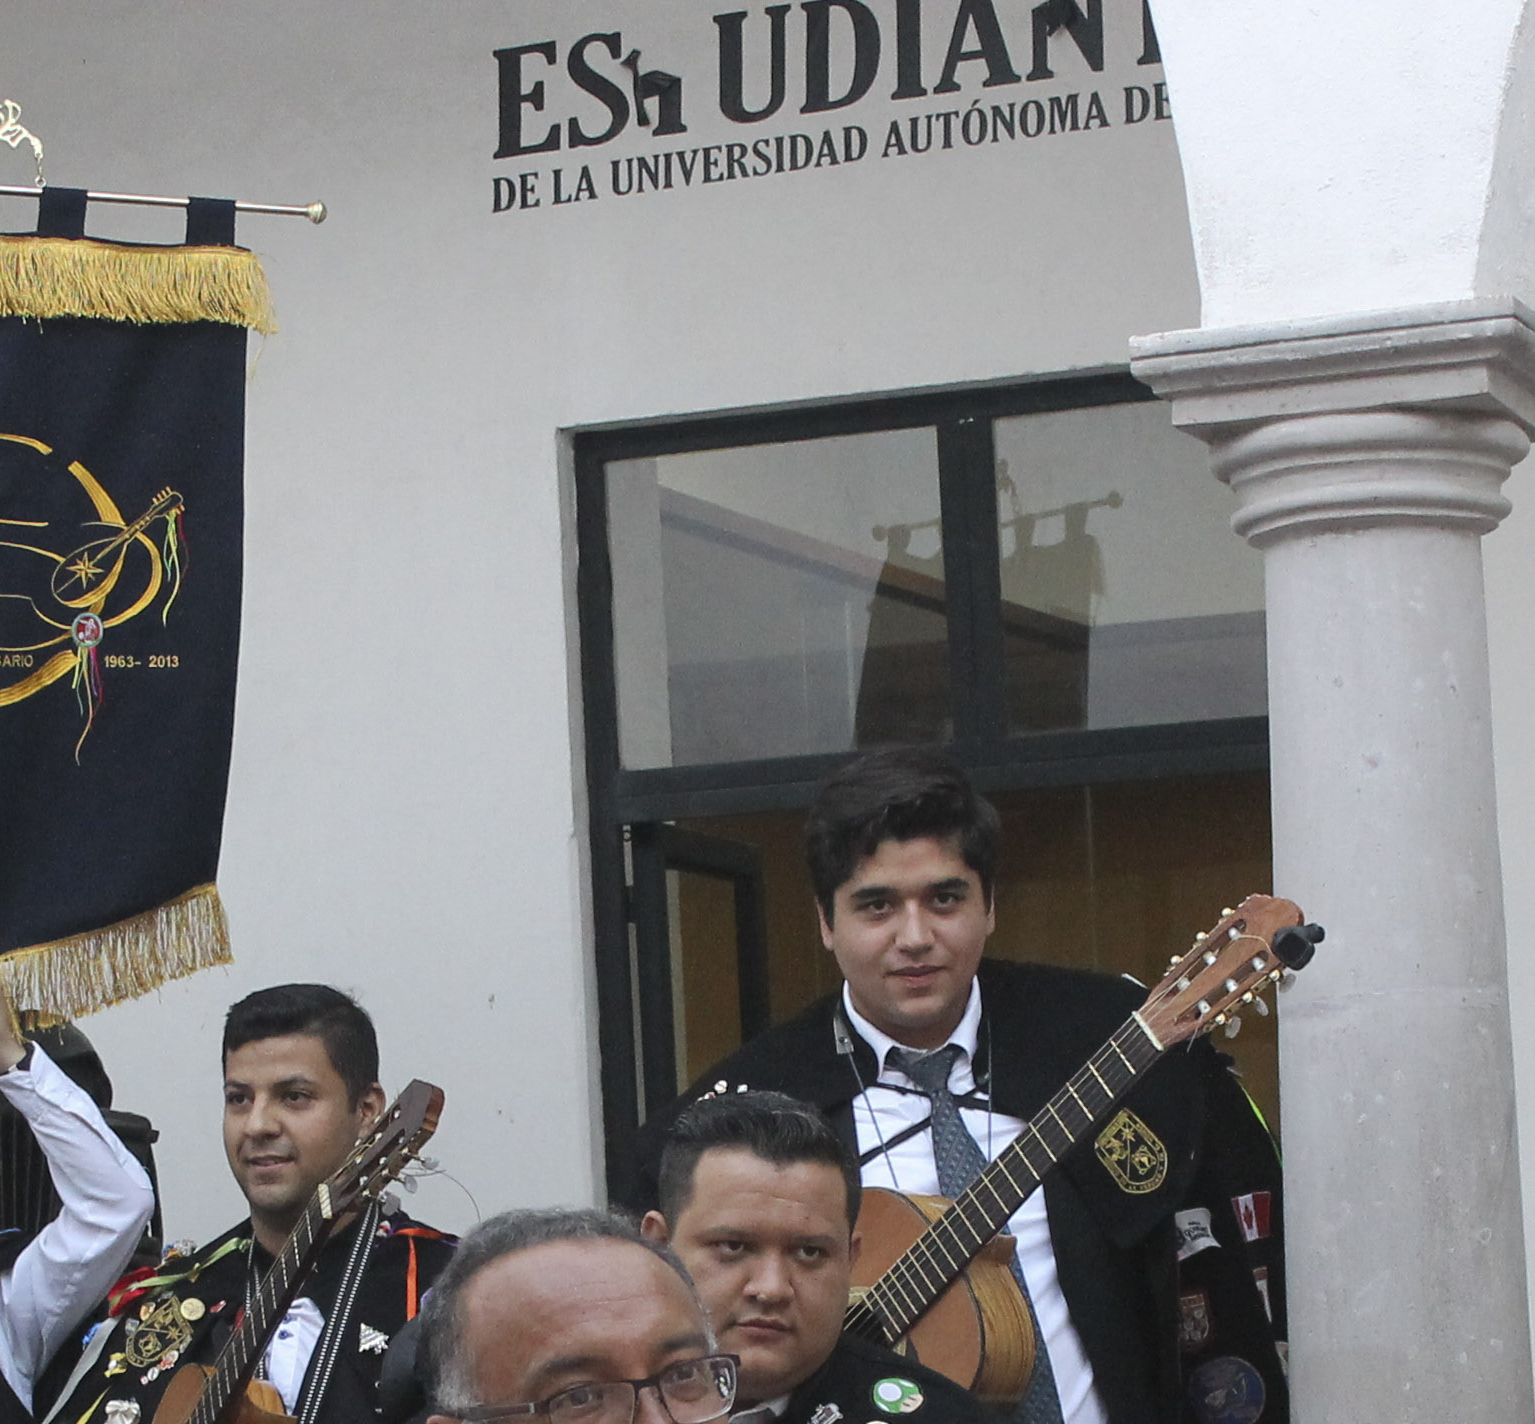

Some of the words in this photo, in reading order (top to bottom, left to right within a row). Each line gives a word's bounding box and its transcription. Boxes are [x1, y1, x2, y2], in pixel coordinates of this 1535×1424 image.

[492, 172, 540, 213] DE
[552, 165, 598, 206] LA
[611, 125, 868, 196] UNIVERSIDAD
[881, 91, 1111, 158] AUTÓNOMA
[149, 655, 180, 668] 2013
